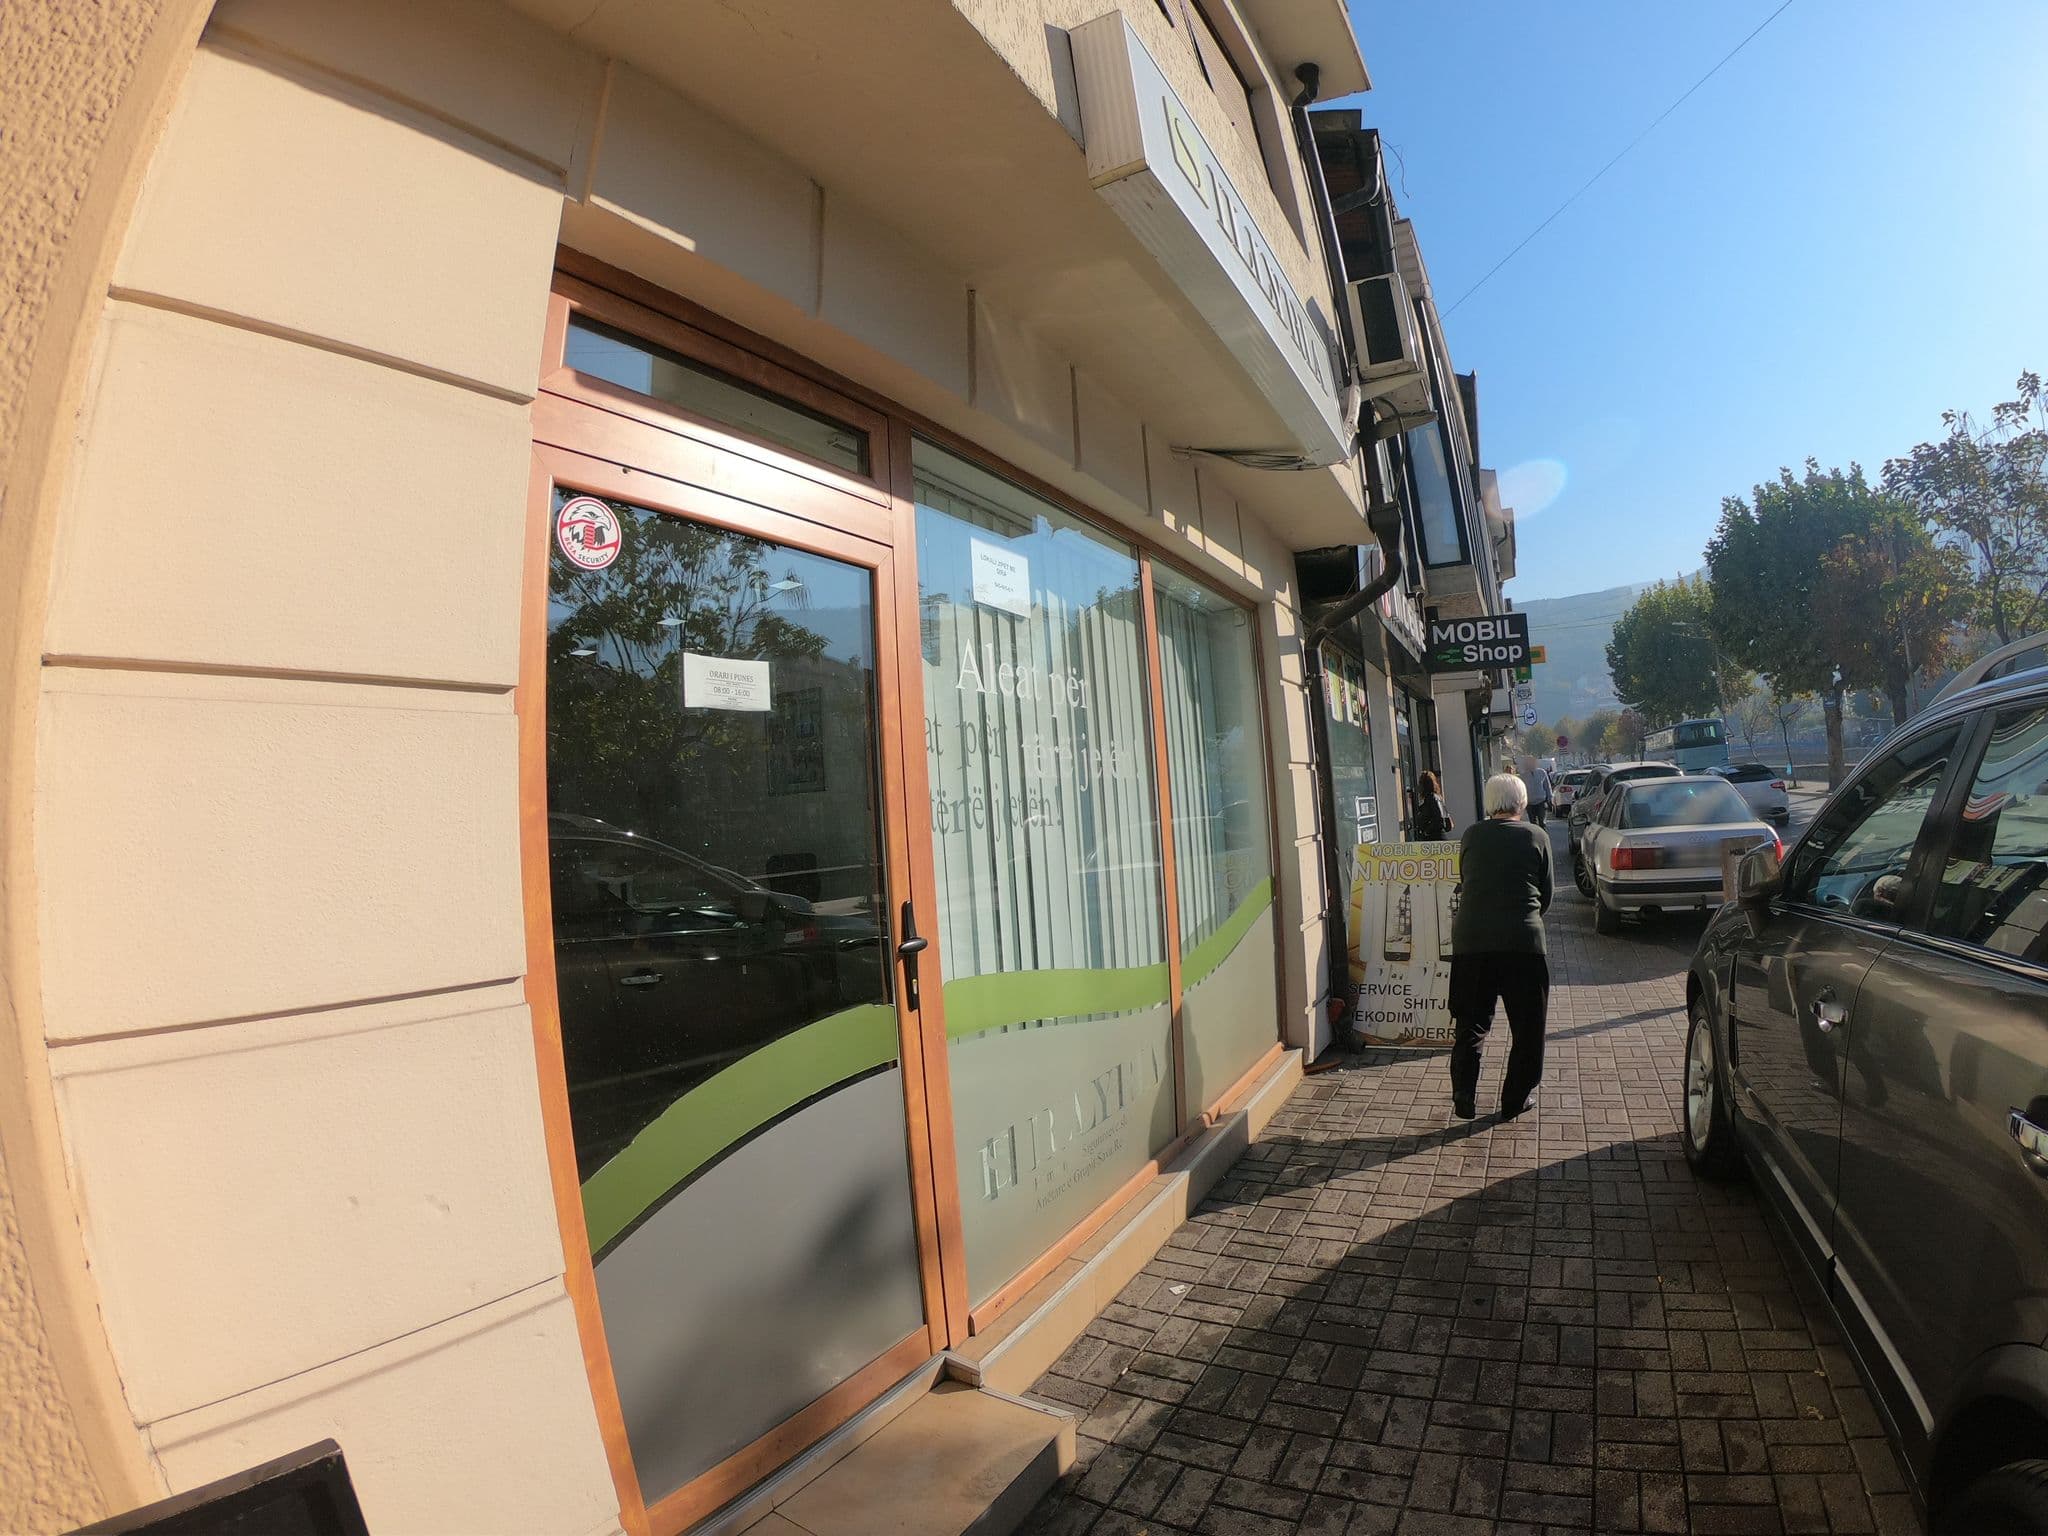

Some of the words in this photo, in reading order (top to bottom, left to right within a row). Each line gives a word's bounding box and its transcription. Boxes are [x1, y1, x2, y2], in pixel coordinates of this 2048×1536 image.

[564, 536, 577, 556] BESA
[578, 551, 609, 564] SECURITY
[1432, 618, 1521, 645] MOBIL
[1463, 643, 1523, 663] Shop
[1371, 845, 1417, 857] MOBIL
[1379, 859, 1461, 881] MOBIL
[1349, 983, 1412, 996] SERVICE
[1351, 1010, 1413, 1023] EKODIM
